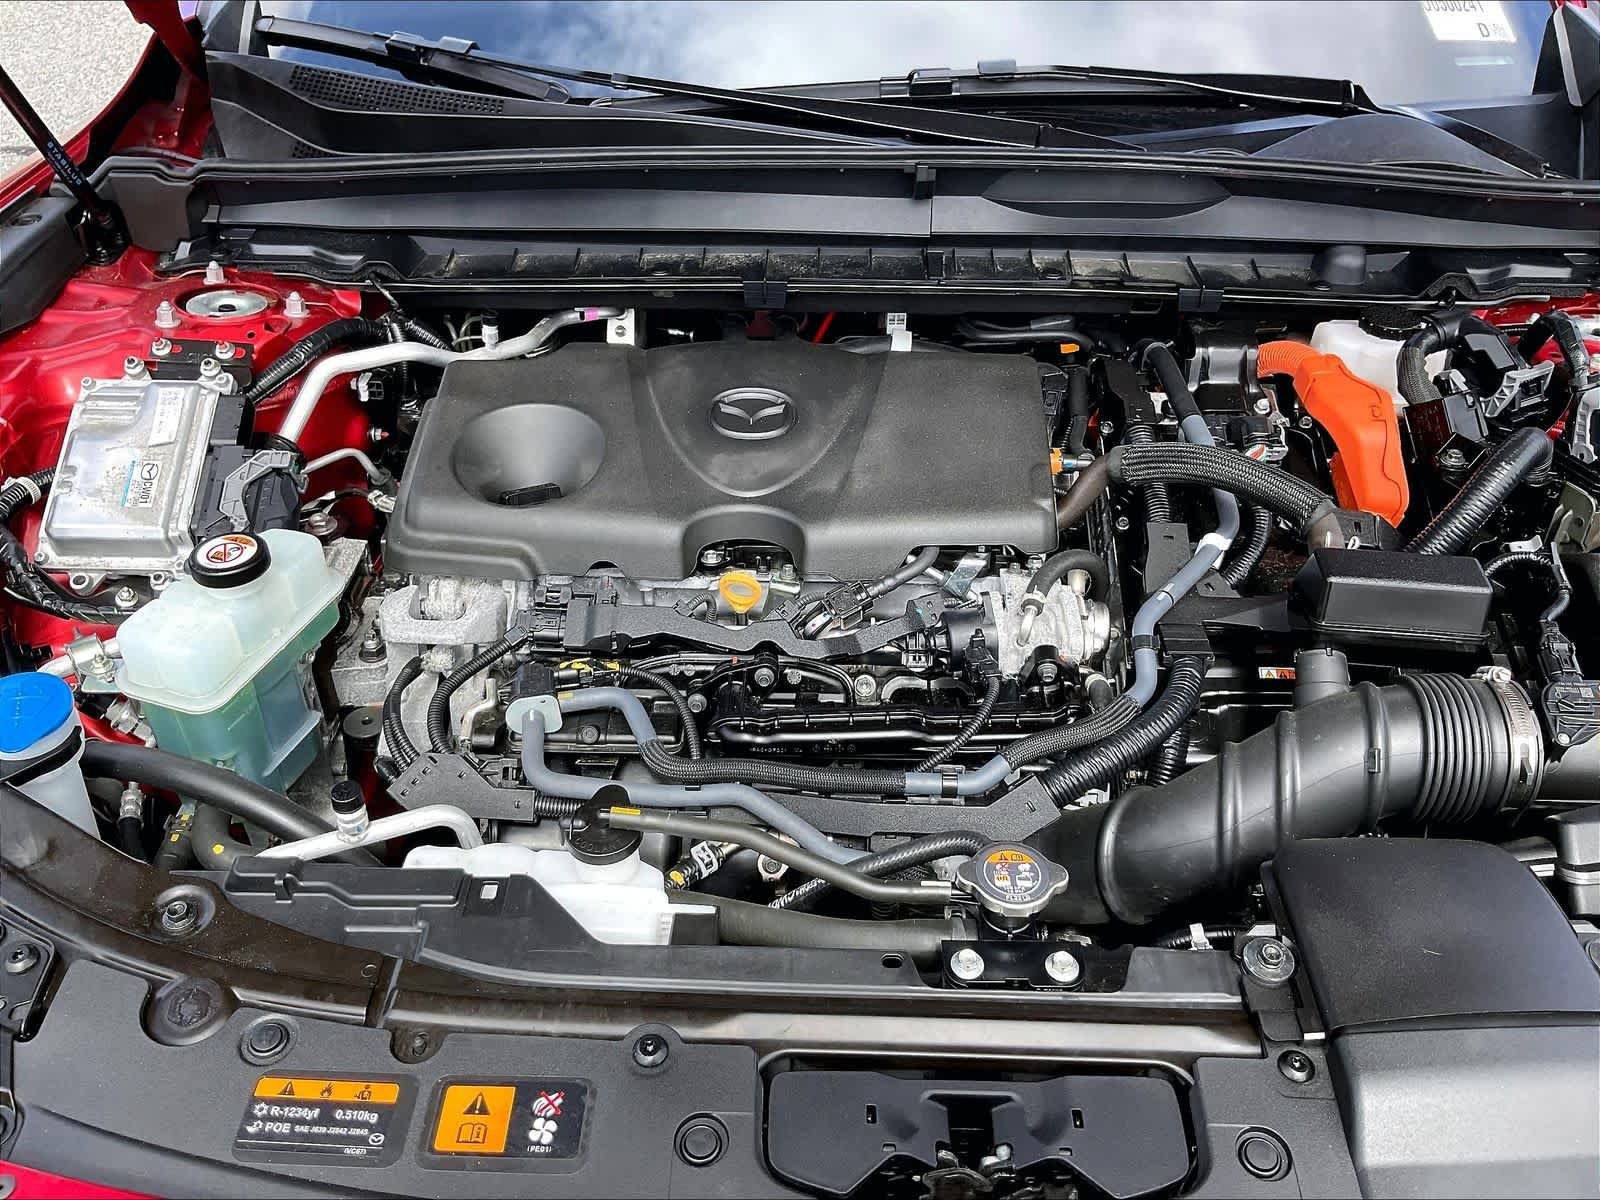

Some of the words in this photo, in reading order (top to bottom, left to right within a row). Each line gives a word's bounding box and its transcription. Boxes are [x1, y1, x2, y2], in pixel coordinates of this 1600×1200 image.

[270, 1105, 320, 1121] R-1234yf
[335, 1109, 379, 1124] 0.510kg
[265, 1121, 291, 1133] POE
